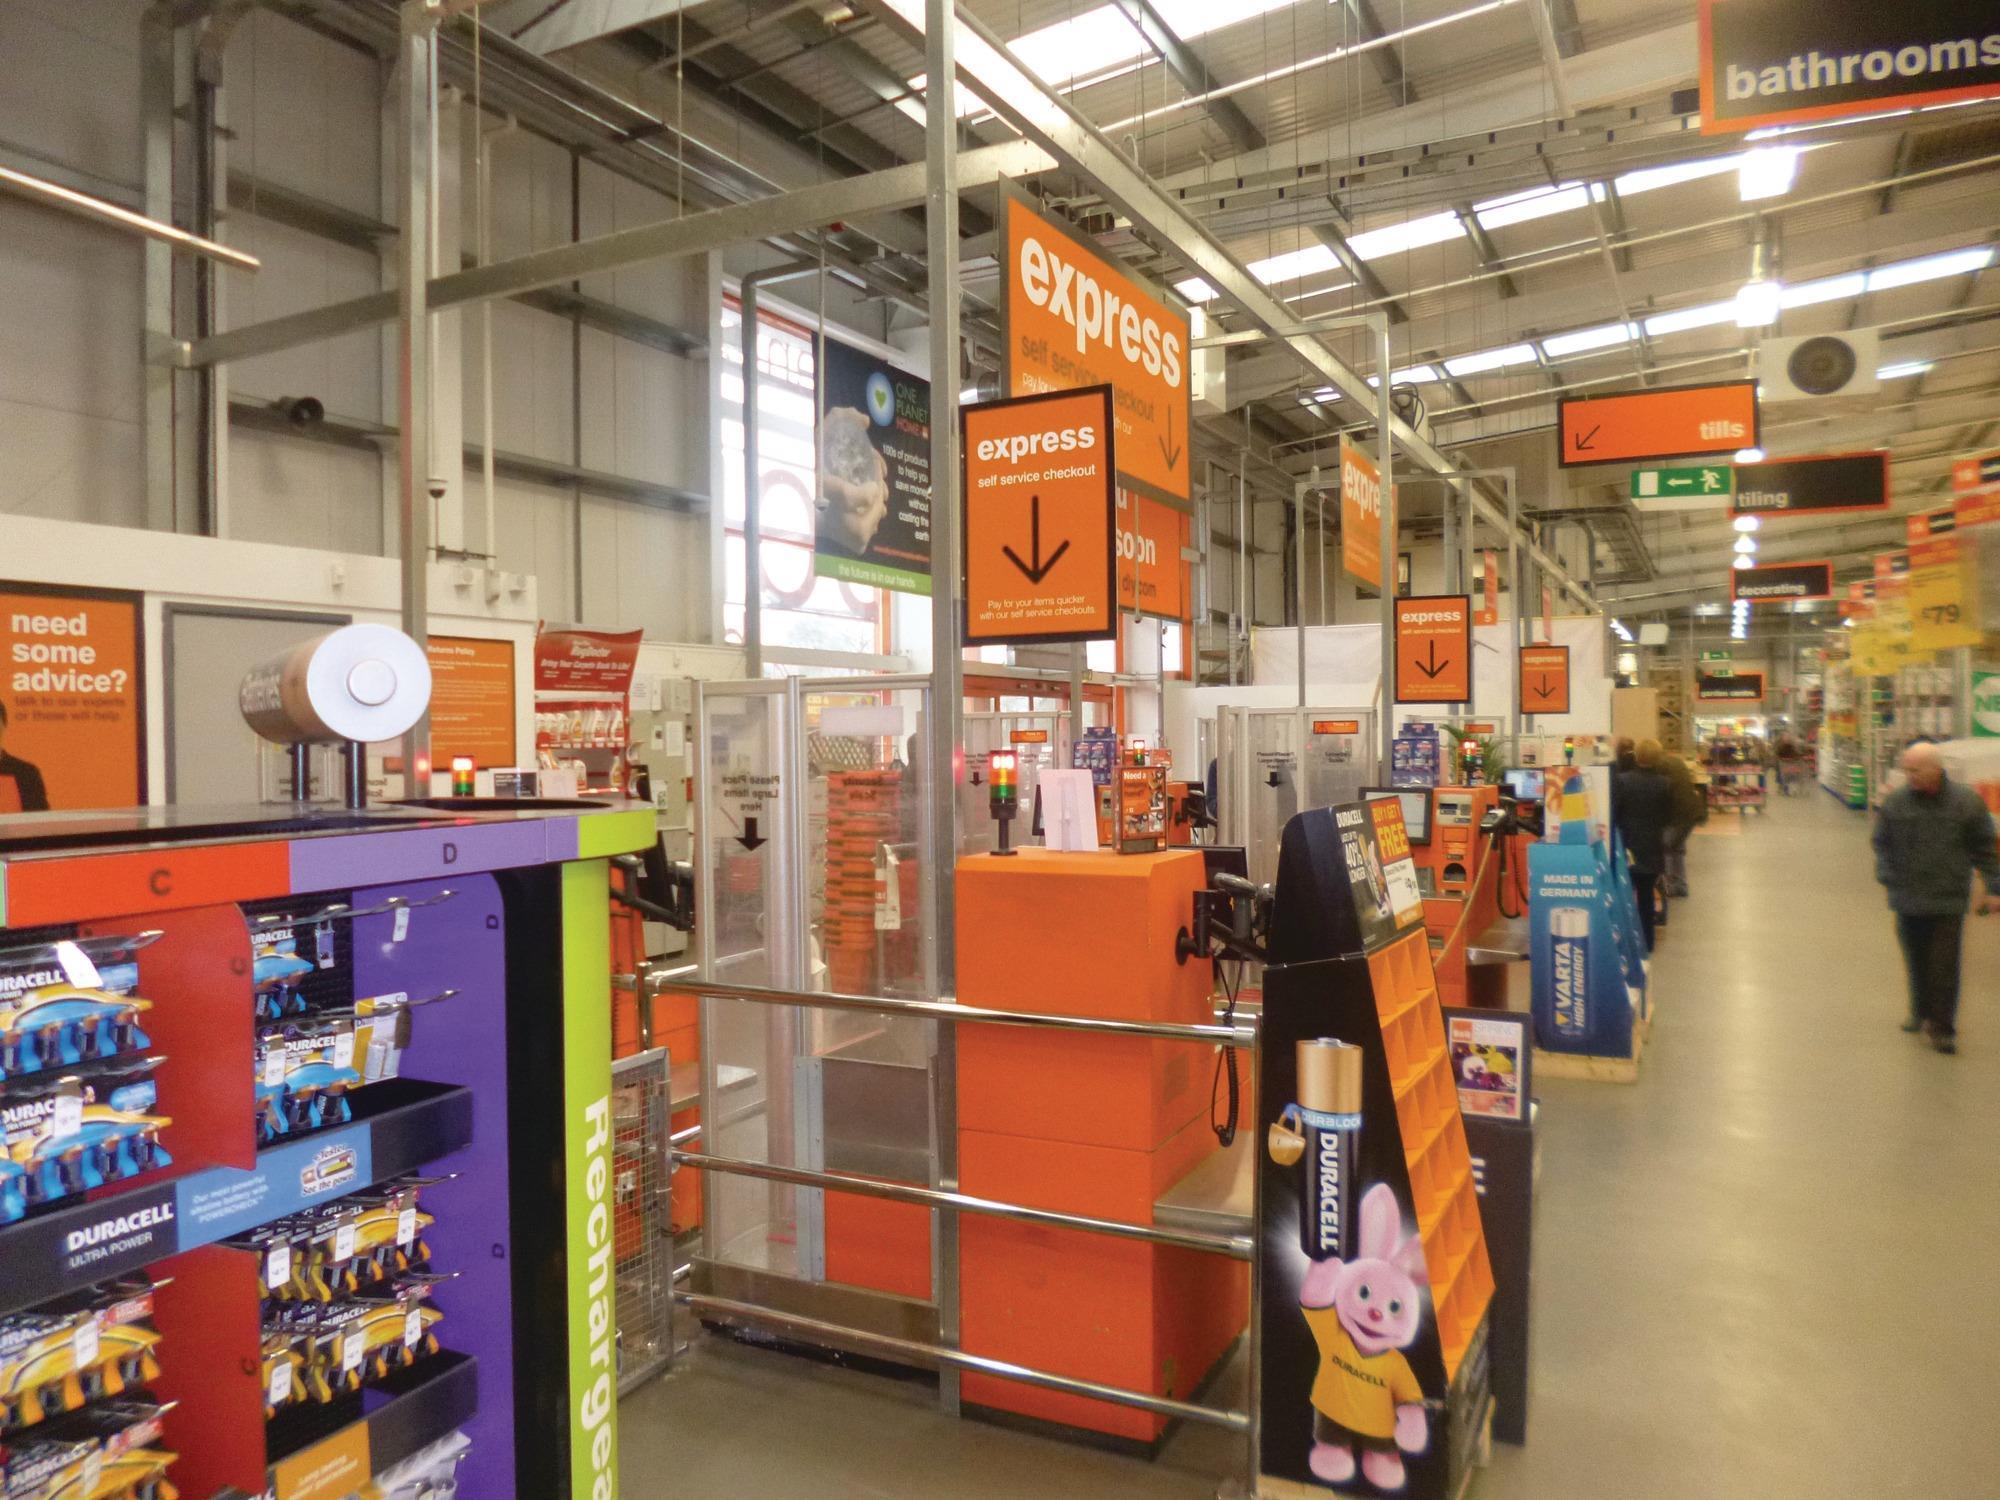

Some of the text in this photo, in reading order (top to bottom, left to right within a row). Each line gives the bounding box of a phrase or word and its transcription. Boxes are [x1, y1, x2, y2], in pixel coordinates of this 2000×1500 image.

[1726, 33, 2000, 100] bathrooms
[1021, 238, 1181, 388] express
[896, 398, 929, 425] PLANET
[1699, 420, 1745, 441] tills
[976, 425, 1096, 465] express
[977, 464, 1096, 488] self service checkout
[1344, 460, 1382, 520] expre
[1738, 490, 1789, 509] tiling
[1737, 583, 1807, 596] decorating
[979, 611, 995, 621] with
[996, 611, 1009, 620] our
[1010, 608, 1024, 619] self
[1025, 608, 1054, 618] service
[987, 600, 1002, 611] Pay
[1003, 599, 1013, 608] for
[1015, 600, 1032, 609] your
[1056, 595, 1085, 607] quicker
[11, 612, 88, 637] need
[1401, 611, 1461, 626] express
[11, 643, 97, 665] some
[11, 668, 128, 693] advice?
[1335, 808, 1364, 829] DURACELL
[1376, 821, 1409, 860] FREE
[442, 843, 458, 864] D
[149, 868, 172, 896] C
[1543, 874, 1594, 885] MADE IN
[1538, 886, 1598, 899] GERMANY
[250, 928, 295, 946] URACELL
[1553, 941, 1572, 1010] VARTA
[1571, 945, 1587, 997] ENERGY
[284, 1035, 338, 1053] DURACEL
[2, 1098, 56, 1125] DURAC
[1319, 1132, 1339, 1251] DURACELL
[66, 1202, 174, 1252] DURACELL
[68, 1231, 153, 1269] ULTRA POWER
[1331, 1354, 1388, 1389] DURACELL
